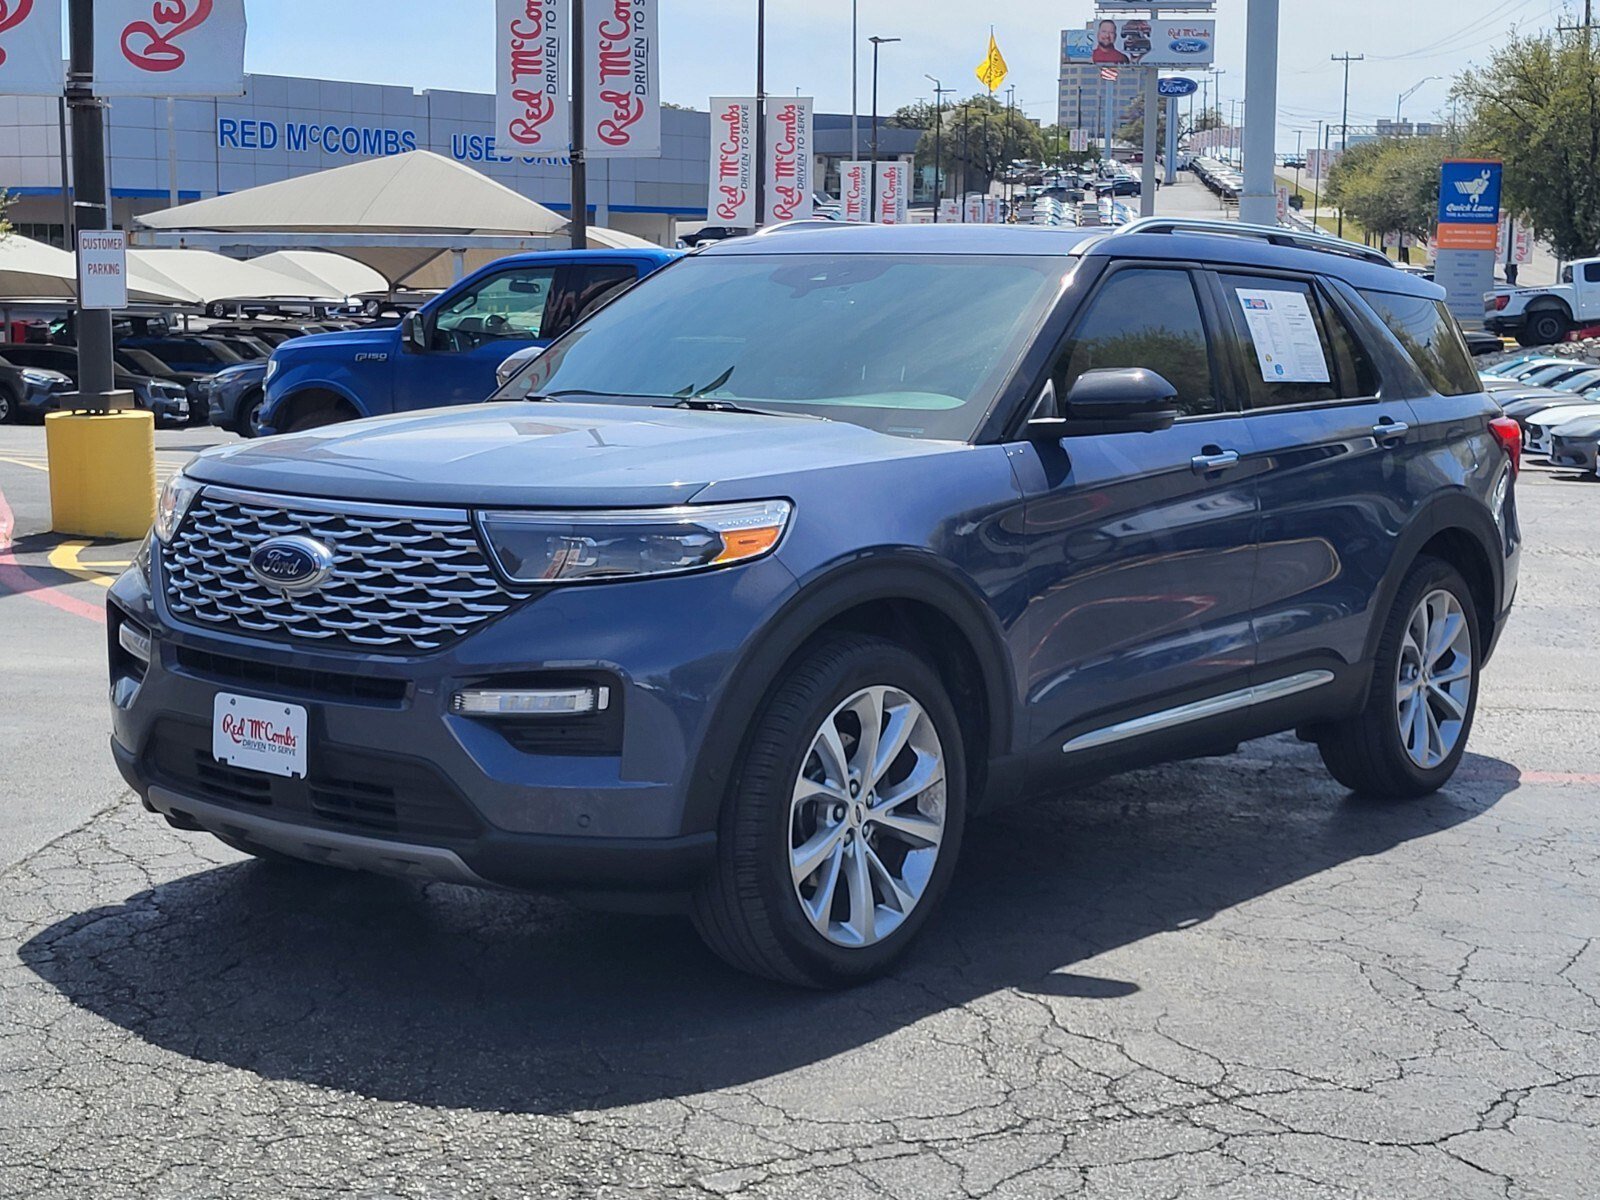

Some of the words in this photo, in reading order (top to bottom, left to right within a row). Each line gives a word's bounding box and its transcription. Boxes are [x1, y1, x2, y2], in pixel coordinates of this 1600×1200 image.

[545, 11, 557, 32] TO
[634, 11, 645, 32] TO
[1175, 41, 1201, 52] Ford
[546, 37, 557, 95] DRIVEN
[634, 38, 646, 95] DRIVEN
[1160, 80, 1189, 93] Ford
[509, 90, 555, 145] Red
[597, 90, 644, 146] Red
[741, 104, 749, 135] SERVE
[797, 104, 805, 135] SERVE
[218, 118, 278, 149] RED
[452, 134, 513, 162] USE
[719, 104, 740, 183] McCombs
[741, 138, 749, 150] TO
[775, 104, 796, 183] McCombs
[797, 138, 805, 150] TO
[741, 153, 749, 190] DRIVEN
[797, 153, 805, 190] DRIVEN
[716, 185, 746, 220] Red
[773, 185, 803, 221] Red
[846, 166, 860, 217] McCombs
[882, 166, 896, 217] McCombs
[1446, 203, 1471, 212] Quick
[1472, 204, 1494, 212] Lane
[82, 238, 123, 250] CUSTOMER
[87, 263, 120, 275] PARKING
[261, 549, 302, 576] Ford
[222, 713, 245, 744] Red
[247, 718, 297, 748] McCombs
[242, 739, 266, 752] DRIVEN
[267, 744, 277, 753] TO
[278, 745, 297, 757] SERVE
